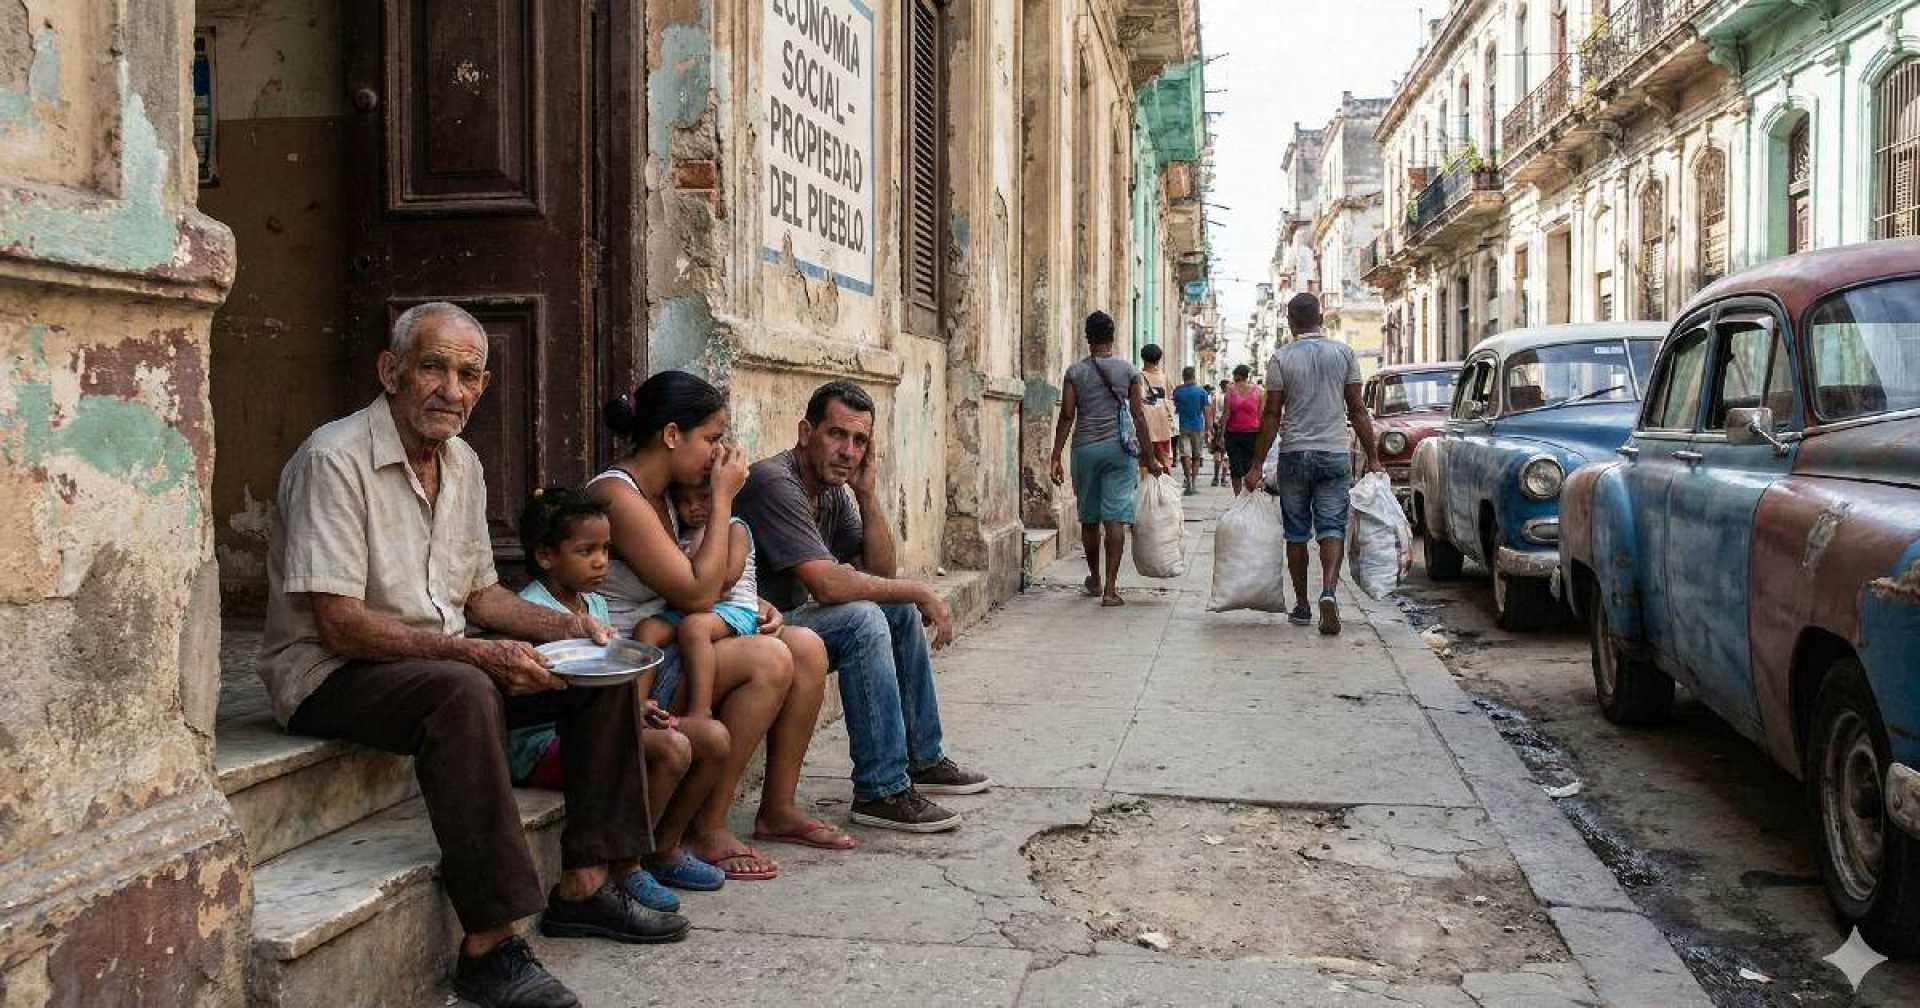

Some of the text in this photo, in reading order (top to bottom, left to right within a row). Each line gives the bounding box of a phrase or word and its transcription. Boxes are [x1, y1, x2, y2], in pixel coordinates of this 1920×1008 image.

[770, 95, 863, 193] PROPIEDAD
[770, 164, 867, 255] DEL PUEBLO.
